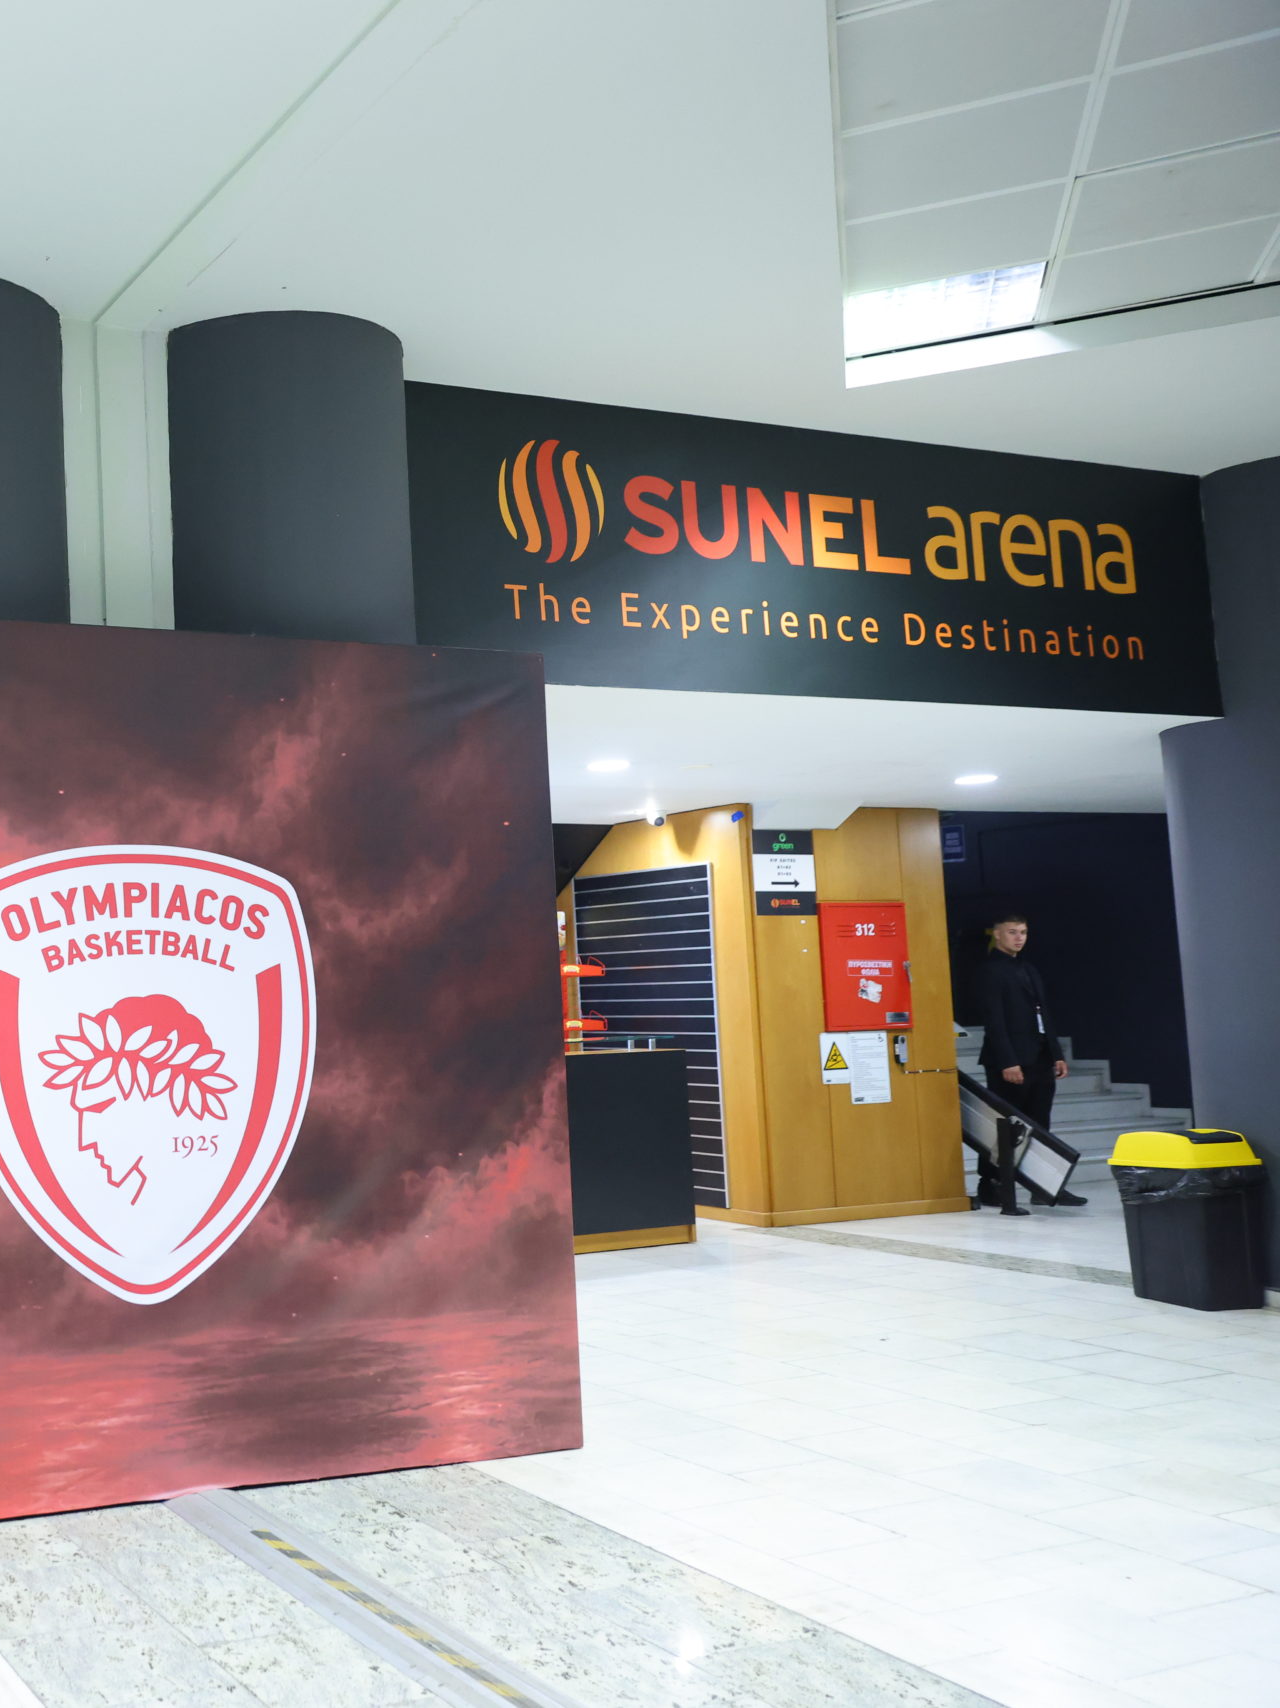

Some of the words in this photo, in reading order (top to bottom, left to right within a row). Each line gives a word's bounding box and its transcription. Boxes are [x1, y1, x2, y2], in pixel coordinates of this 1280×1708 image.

[623, 475, 912, 575] SUNEL
[923, 505, 1137, 594] arena
[503, 583, 592, 625] The
[620, 592, 880, 643] Experience
[902, 612, 1145, 660] Destination
[0, 882, 270, 942] OLYMPIACOS
[855, 923, 876, 936] 312
[41, 929, 236, 973] BASKETBALL
[172, 1134, 219, 1159] 1925
